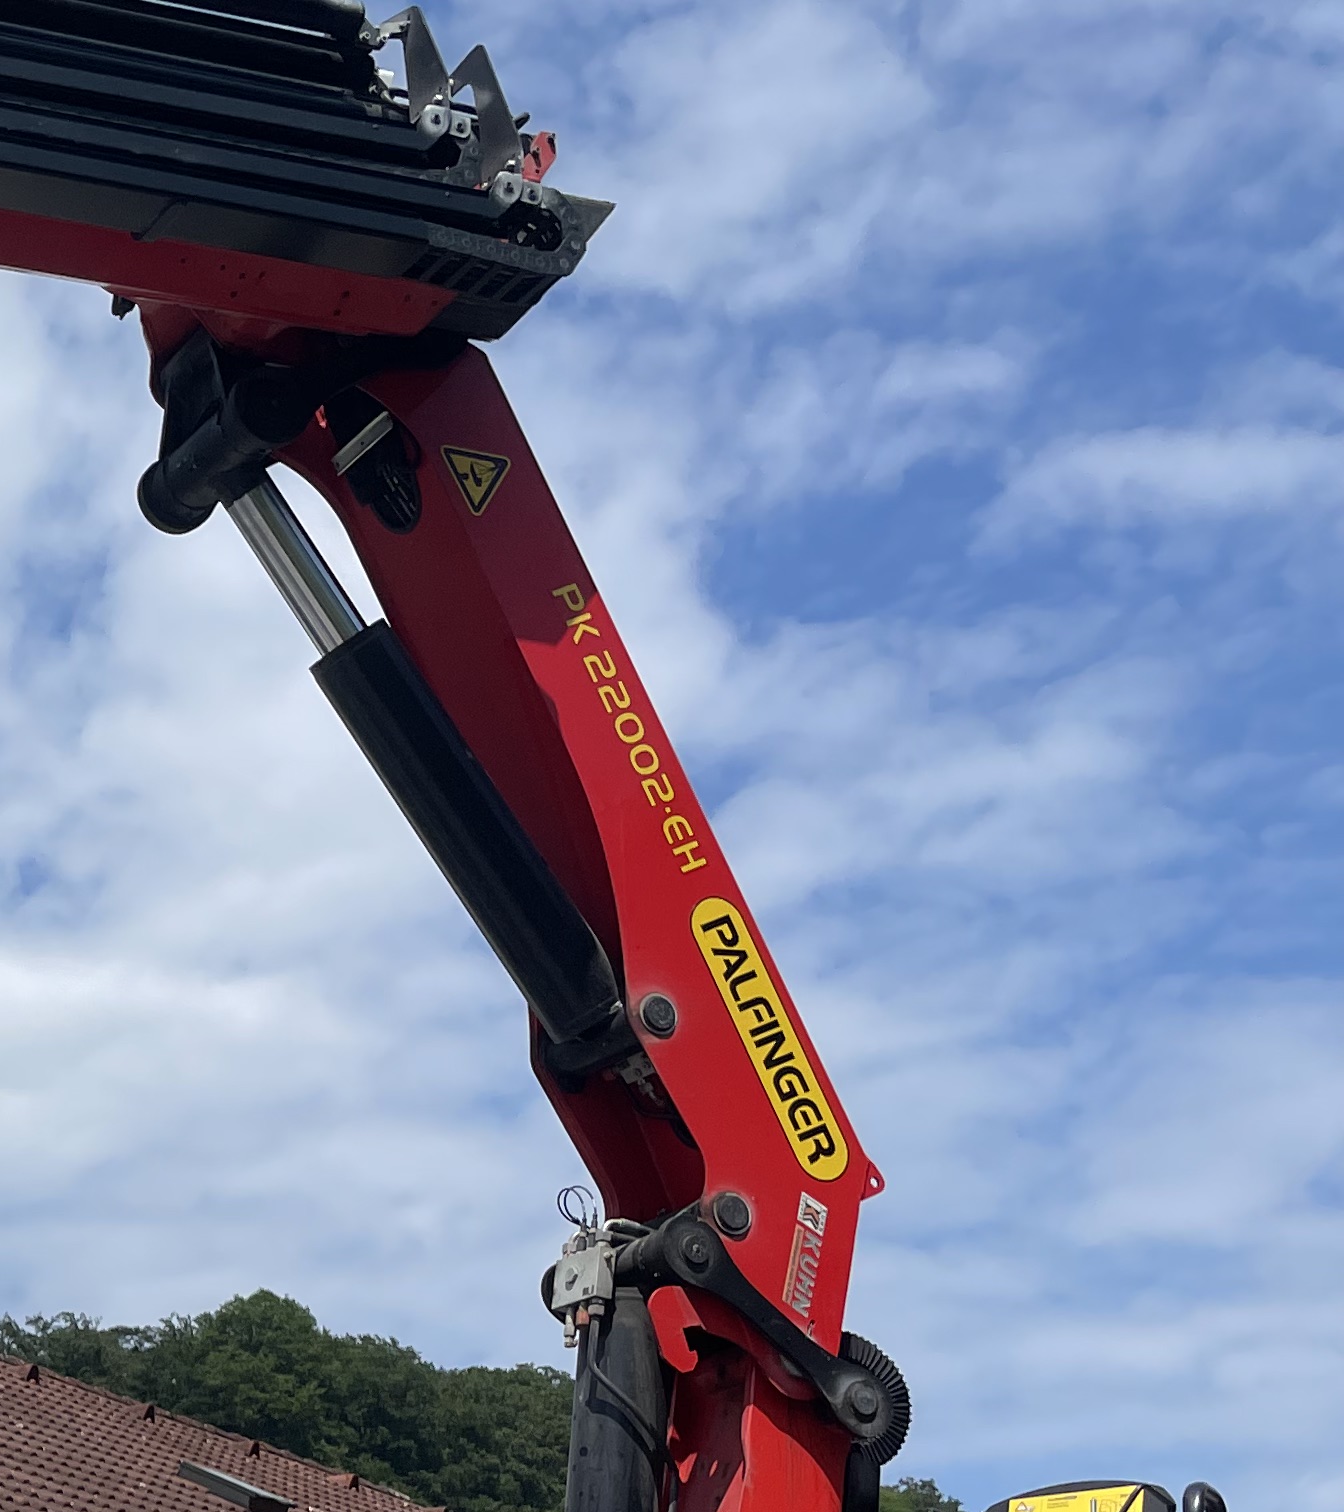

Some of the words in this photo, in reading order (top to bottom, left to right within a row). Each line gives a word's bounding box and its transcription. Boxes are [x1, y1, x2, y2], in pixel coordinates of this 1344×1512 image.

[551, 582, 601, 645] PK
[700, 914, 836, 1165] PALFINGER
[791, 1230, 823, 1318] KUHN
